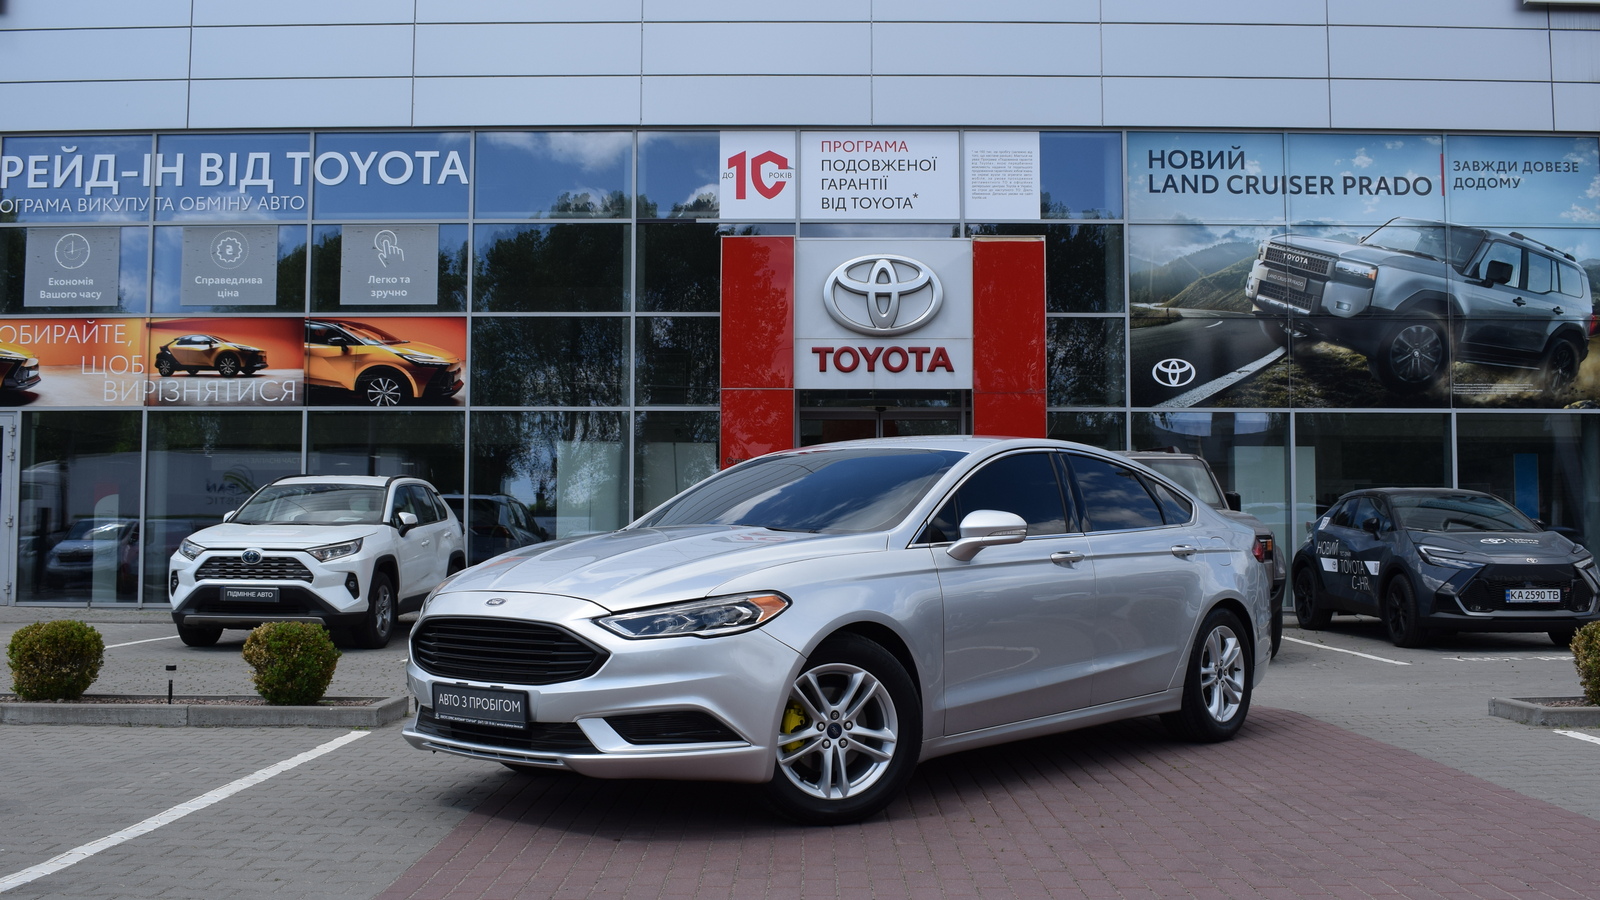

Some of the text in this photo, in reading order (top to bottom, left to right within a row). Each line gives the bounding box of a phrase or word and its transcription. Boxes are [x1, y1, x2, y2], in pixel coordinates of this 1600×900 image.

[821, 140, 908, 152] ПРОГРАМА
[821, 155, 938, 174] ПОДОВЖЕНОЇ
[1148, 146, 1245, 170] НОВИЙ
[200, 152, 274, 194] ВІД
[286, 150, 469, 186] TOYOTA
[1453, 161, 1579, 174] ЗАВЖДИ ДОВЕЗЕ
[722, 172, 734, 180] ДО
[821, 174, 888, 190] ГАРАНТІЇ
[1453, 176, 1521, 191] ДОДОМУ
[1148, 174, 1432, 196] LAND CRUISER PRADO
[78, 197, 150, 212] ВИКУПУ
[154, 197, 174, 211] ТА
[180, 196, 252, 212] ОБМІНУ
[257, 196, 305, 210] АВТО
[821, 197, 847, 212] ВІД
[1283, 253, 1308, 265] TOYOTA
[48, 277, 94, 286] Економія
[195, 276, 263, 286] Справедлива
[368, 275, 398, 284] Легко
[40, 290, 77, 299] Вашого
[217, 289, 239, 298] ціна
[371, 290, 408, 298] зручно
[81, 355, 144, 378] ЩОБ
[812, 346, 954, 373] TOYOTA
[104, 380, 296, 402] ВИРІЗНЯТИСЯ
[1316, 539, 1339, 556] НОВИЙ
[1340, 559, 1366, 575] TOYOTA
[1351, 575, 1370, 591] C-HR
[1525, 591, 1545, 599] 2590
[438, 693, 460, 706] АВТО
[469, 696, 521, 713] ПРОБІГОМ
